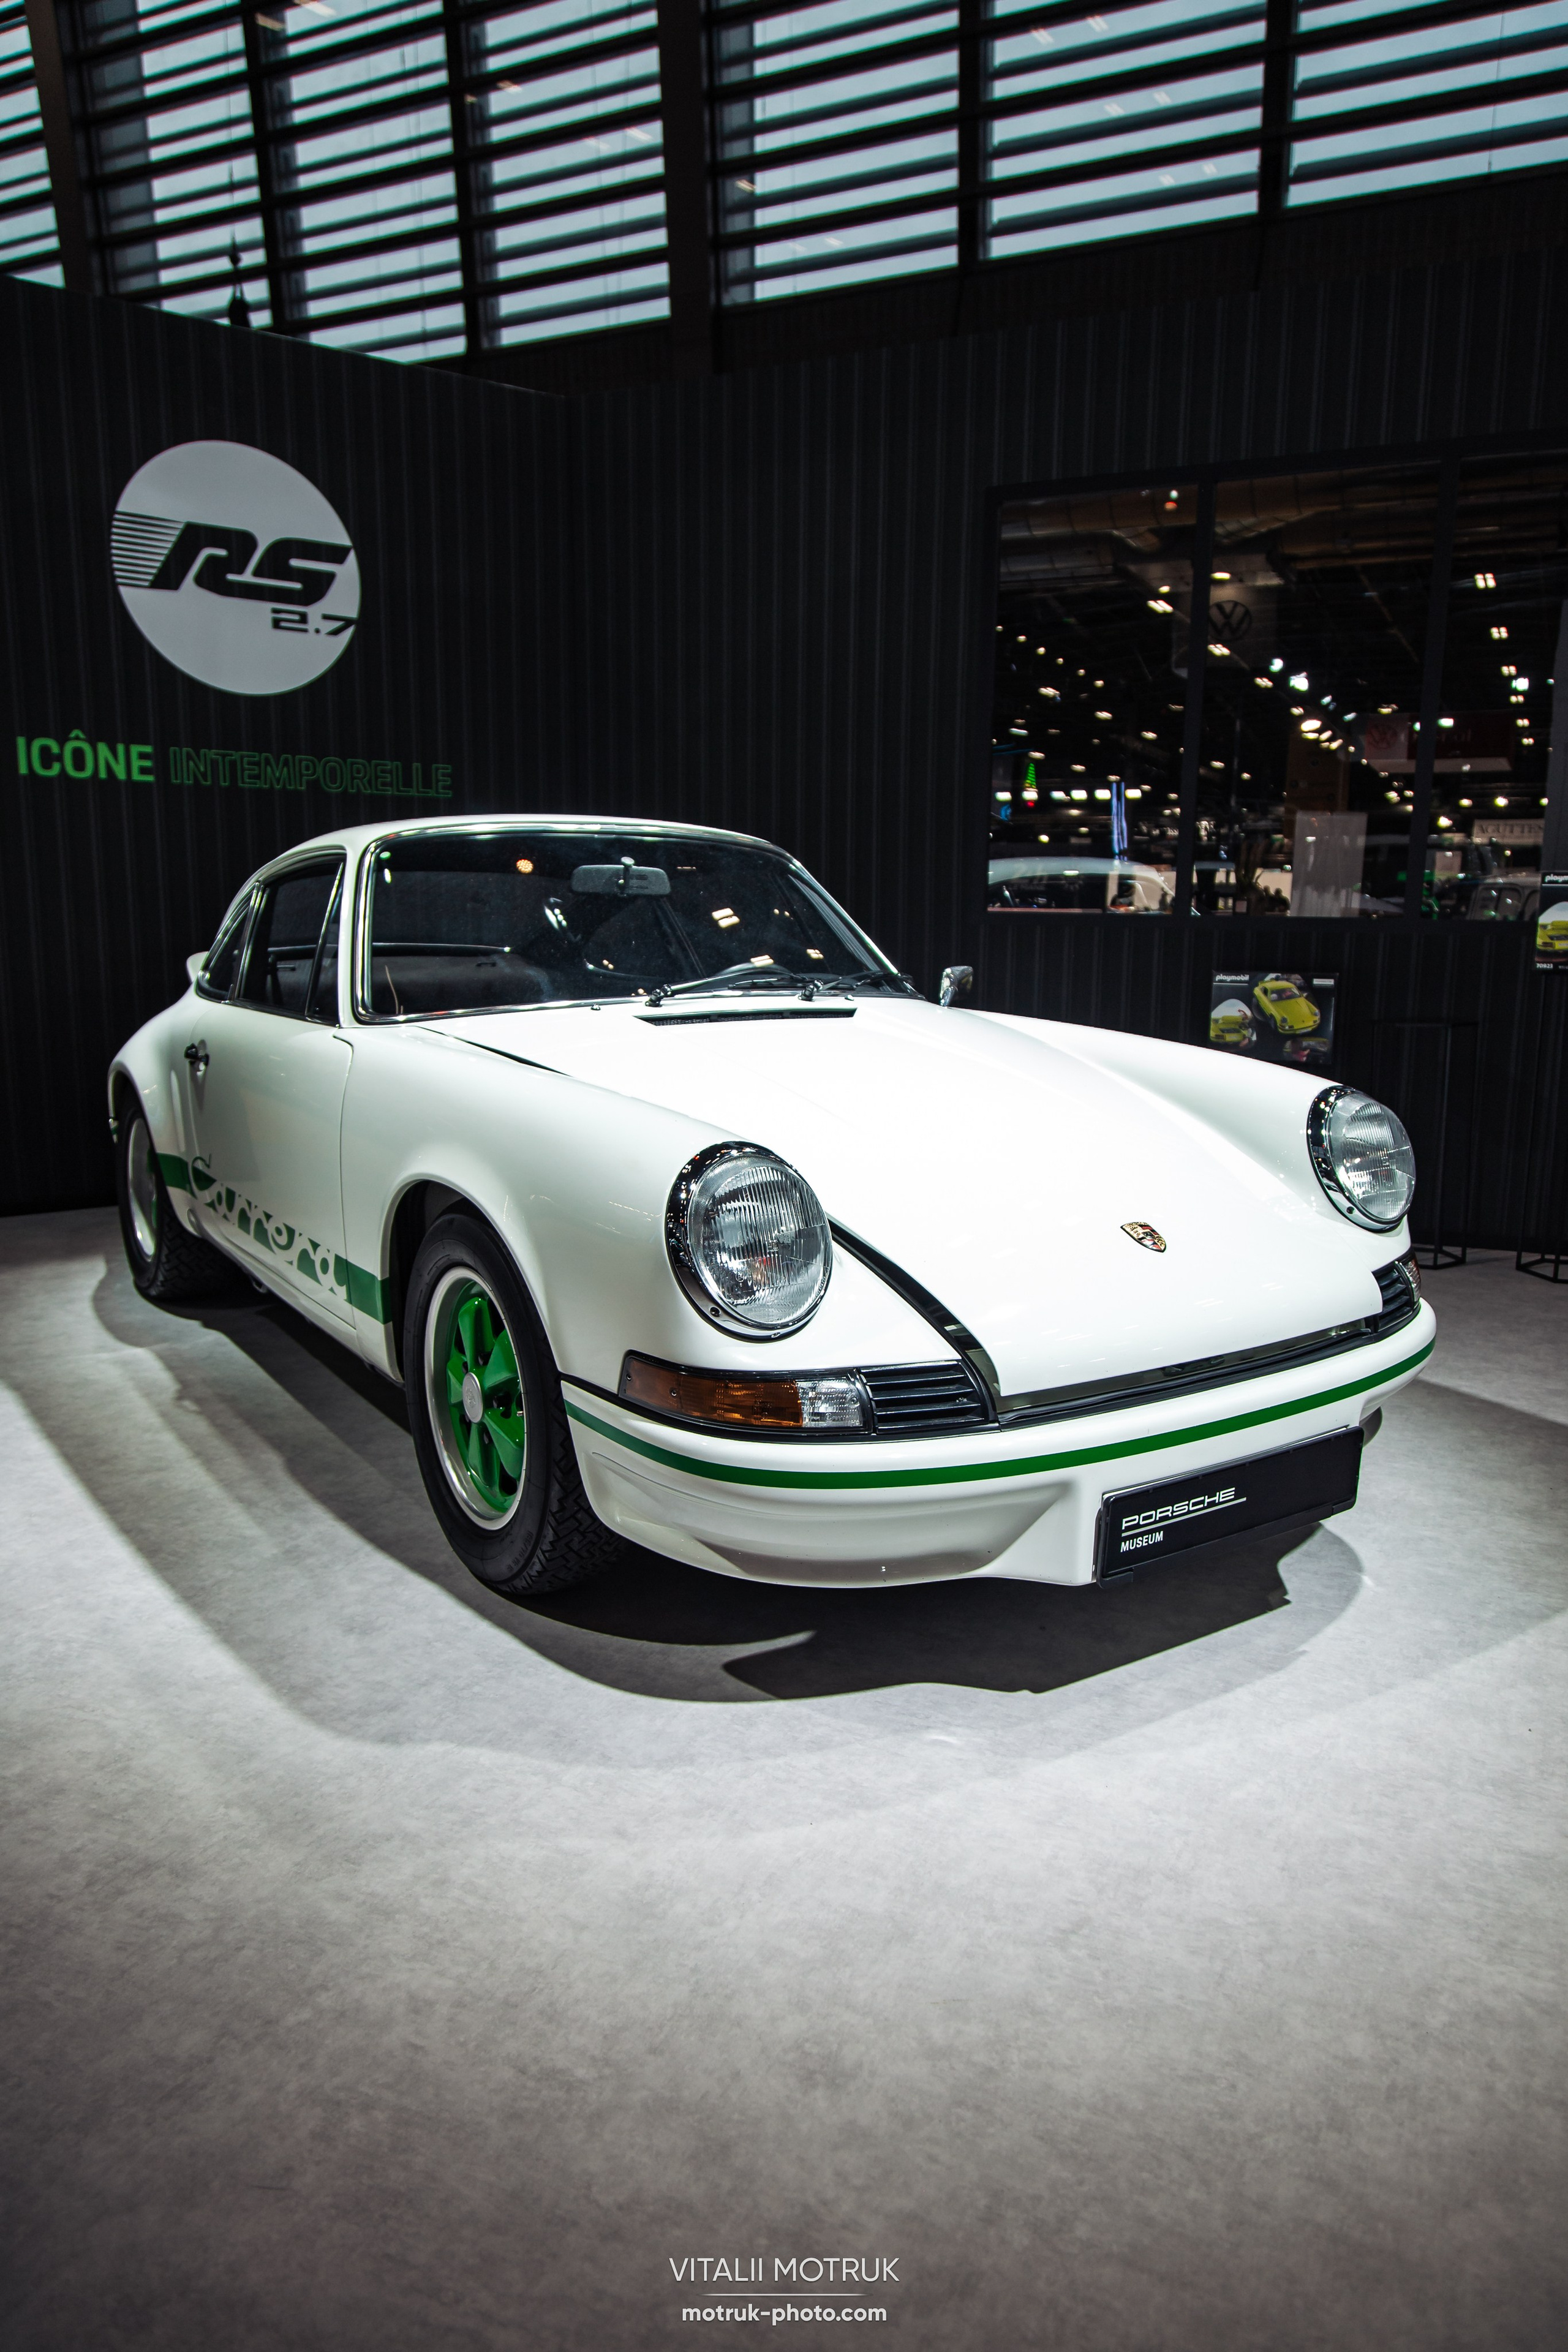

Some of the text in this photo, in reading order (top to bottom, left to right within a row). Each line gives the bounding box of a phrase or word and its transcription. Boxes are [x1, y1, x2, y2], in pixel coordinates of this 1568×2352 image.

[149, 521, 353, 607] RS
[271, 607, 358, 636] 2.7
[17, 729, 453, 797] ICÔNE INTEMPORELLE
[186, 1153, 347, 1301] Carrera
[1121, 1487, 1235, 1530] PORSCHE
[1120, 1530, 1164, 1553] MUSEUM
